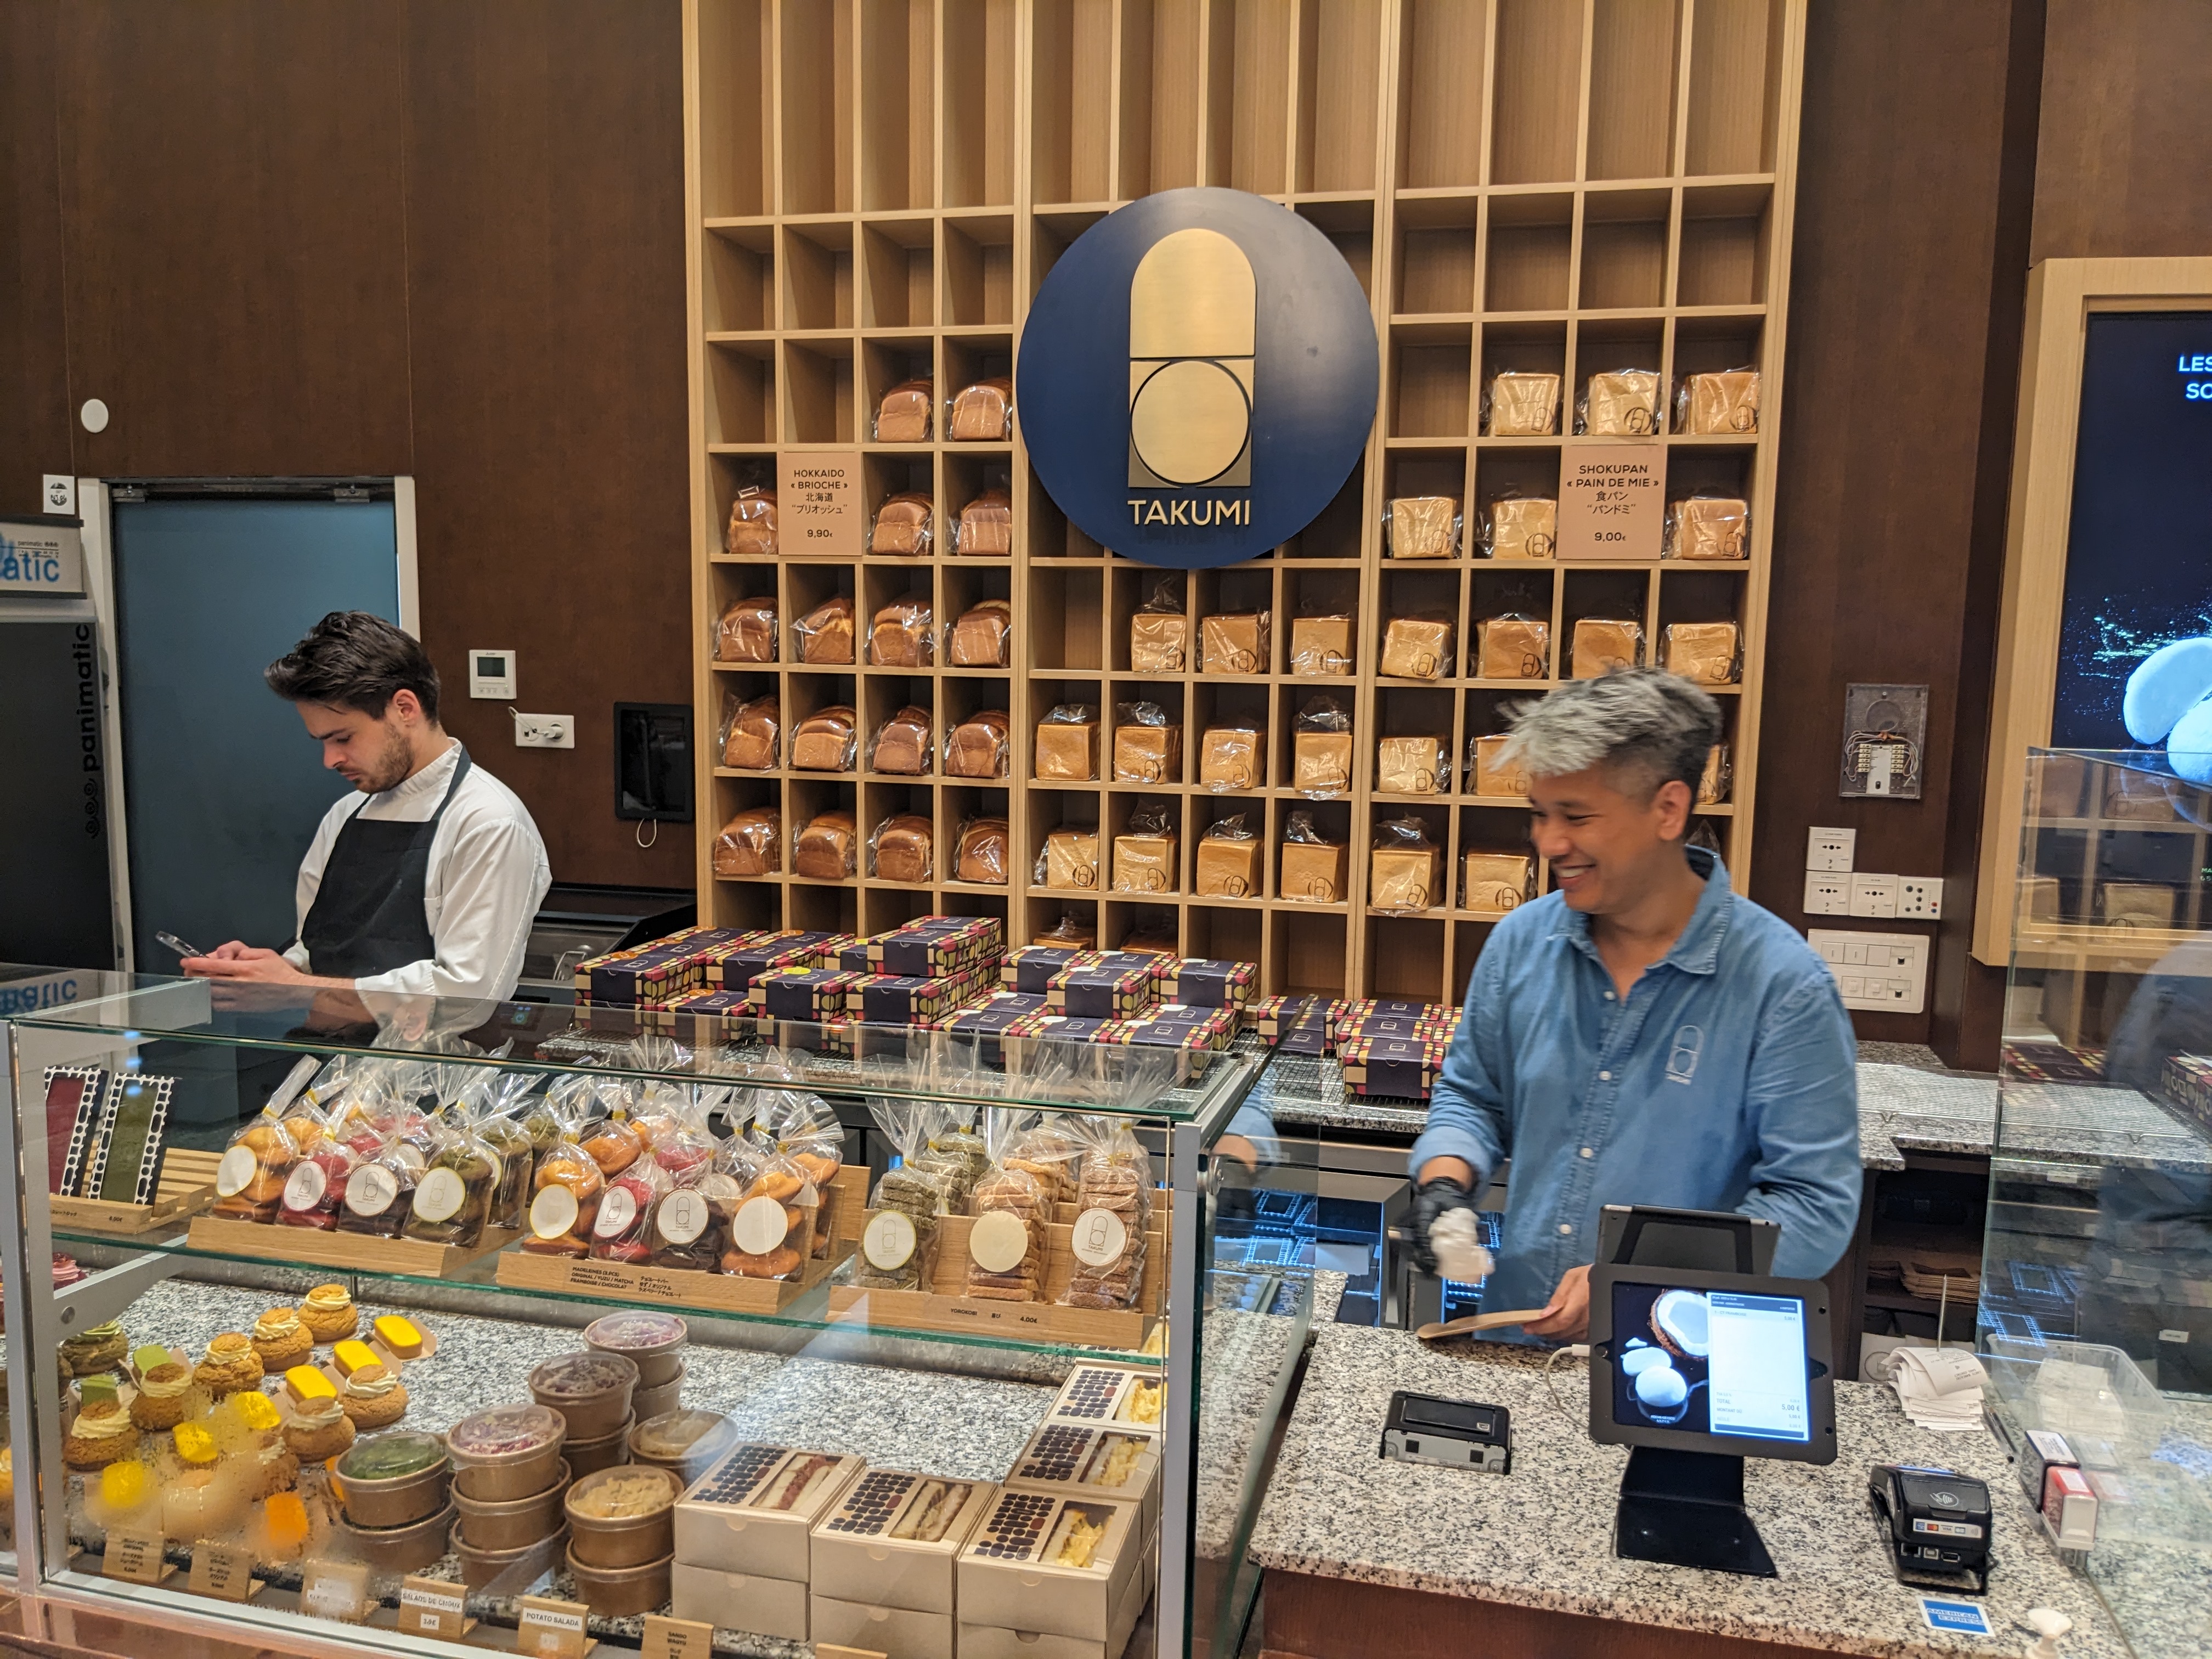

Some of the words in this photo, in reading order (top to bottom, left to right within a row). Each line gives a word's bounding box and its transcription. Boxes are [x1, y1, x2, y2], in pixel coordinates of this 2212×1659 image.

[794, 470, 845, 478] HOKKAIDO
[1579, 465, 1648, 474] SHOKUPAN
[798, 481, 841, 489] BRIOCHE
[1576, 478, 1605, 487] PAIN
[1609, 478, 1624, 487] DE
[1628, 478, 1650, 487] MIE
[805, 492, 833, 503] 北海道
[1596, 491, 1628, 501] 食パン
[1127, 500, 1251, 526] TAKUMI
[807, 529, 833, 538] 9,90€
[1594, 532, 1626, 542] 9,00€
[0, 551, 59, 582] atic
[72, 623, 101, 773] panimatic
[573, 1267, 602, 1275] MADELEINES
[1926, 1607, 1979, 1620] AMERICAN
[527, 1612, 552, 1622] POTATO
[554, 1617, 579, 1626] SALADA
[1937, 1614, 1984, 1626] EXPRESS
